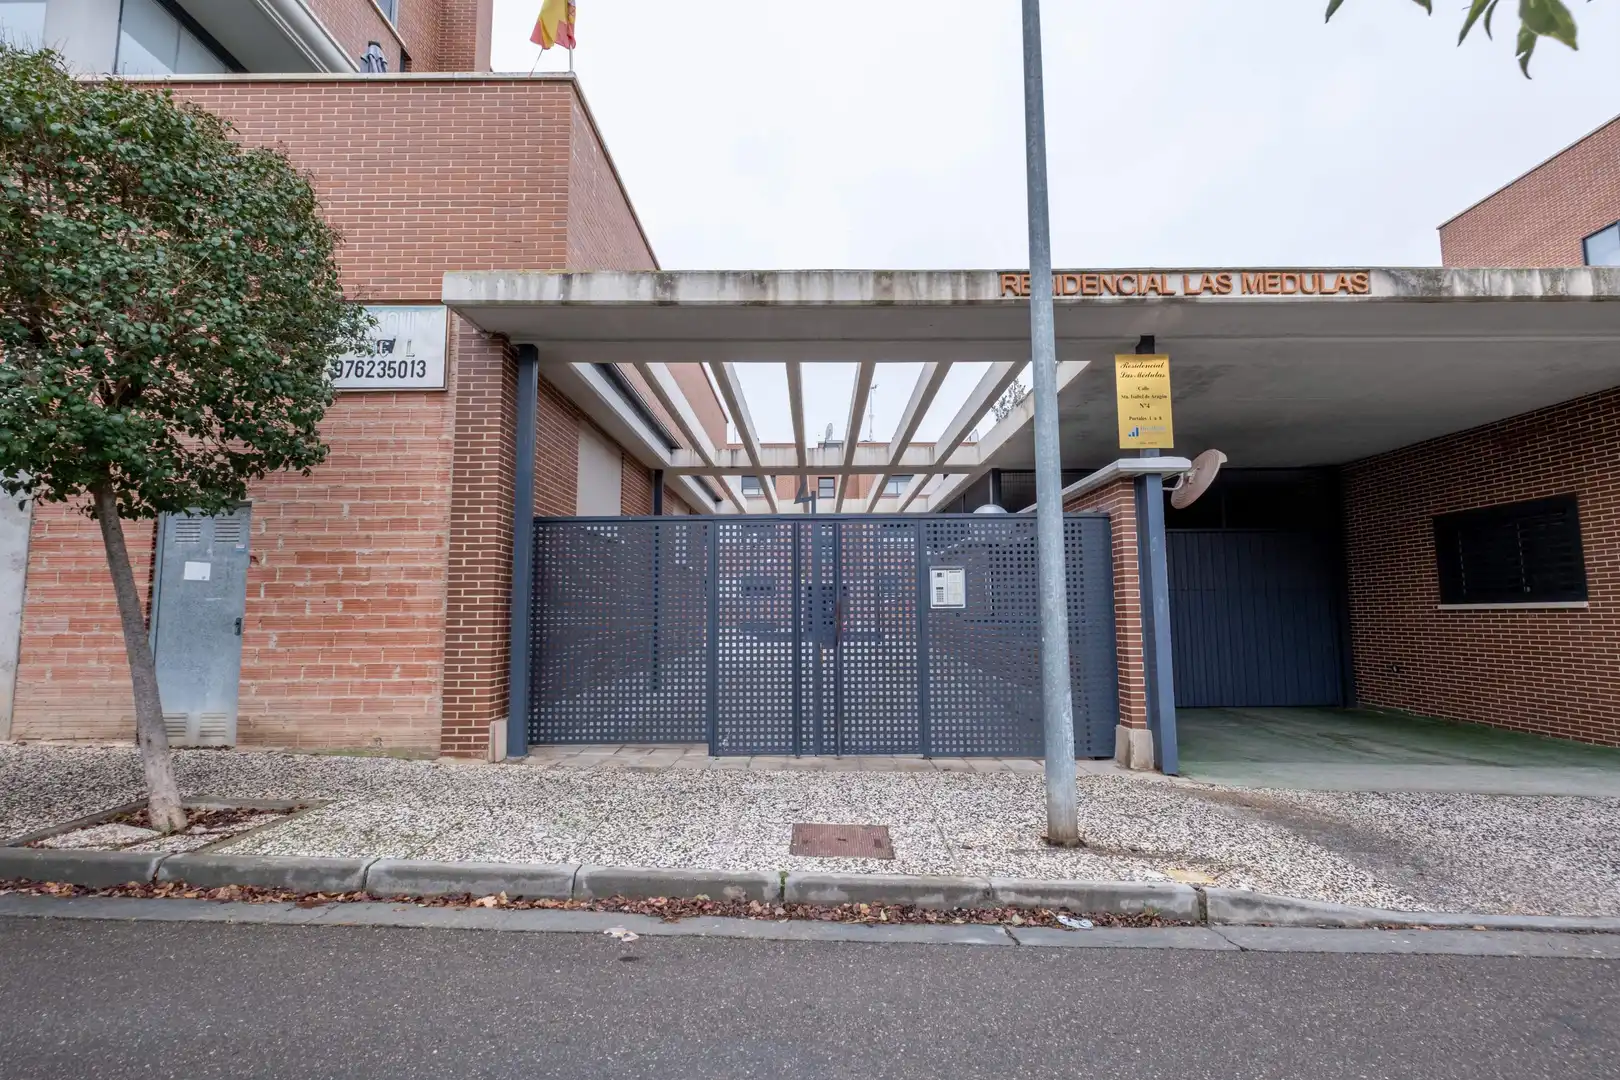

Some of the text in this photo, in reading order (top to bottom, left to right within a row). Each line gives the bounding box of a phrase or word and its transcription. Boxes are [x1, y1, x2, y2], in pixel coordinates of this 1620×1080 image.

[1000, 272, 1371, 296] REIDENCIAL LAS MEDULAS
[334, 360, 427, 378] 976235013
[1120, 361, 1164, 369] Residencial
